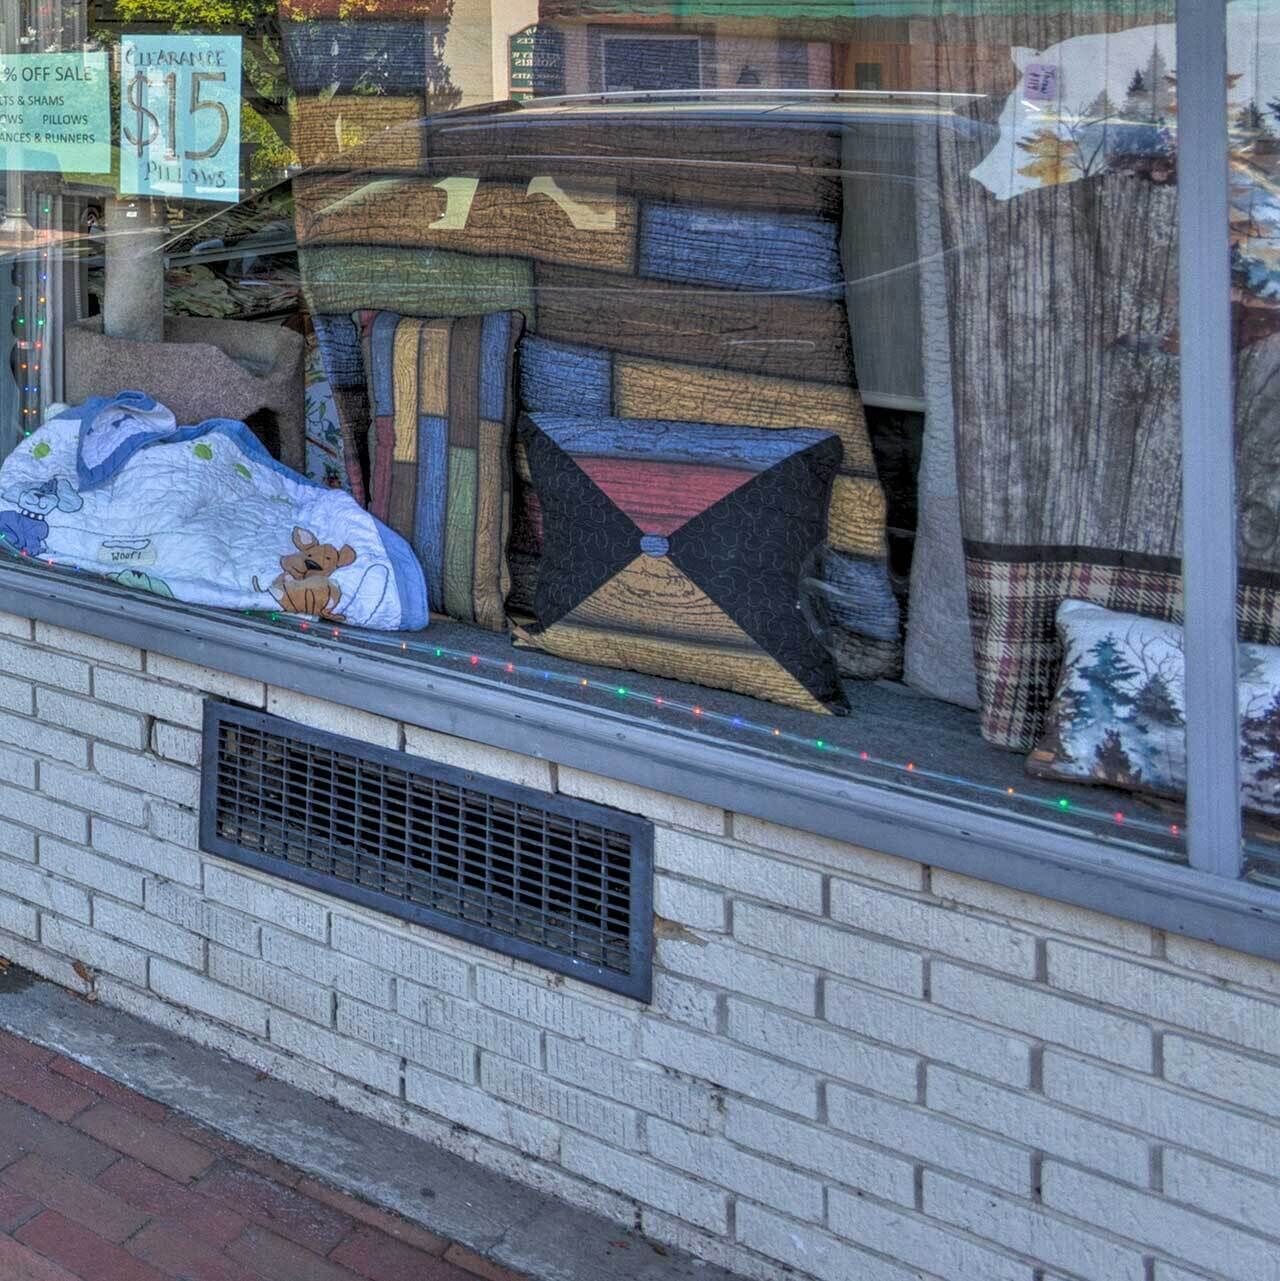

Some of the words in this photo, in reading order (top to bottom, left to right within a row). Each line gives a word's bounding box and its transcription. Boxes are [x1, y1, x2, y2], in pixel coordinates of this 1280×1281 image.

[125, 48, 228, 68] CLEARANCE
[4, 67, 17, 81] %
[21, 67, 51, 81] OFF
[54, 66, 92, 81] SALE
[17, 95, 26, 106] &
[28, 95, 65, 106] SHAMS
[42, 113, 89, 125] PILLOWS
[123, 71, 230, 160] $15
[34, 132, 42, 143] &
[44, 132, 96, 144] RUNNERS
[143, 161, 226, 188] PILLOWS
